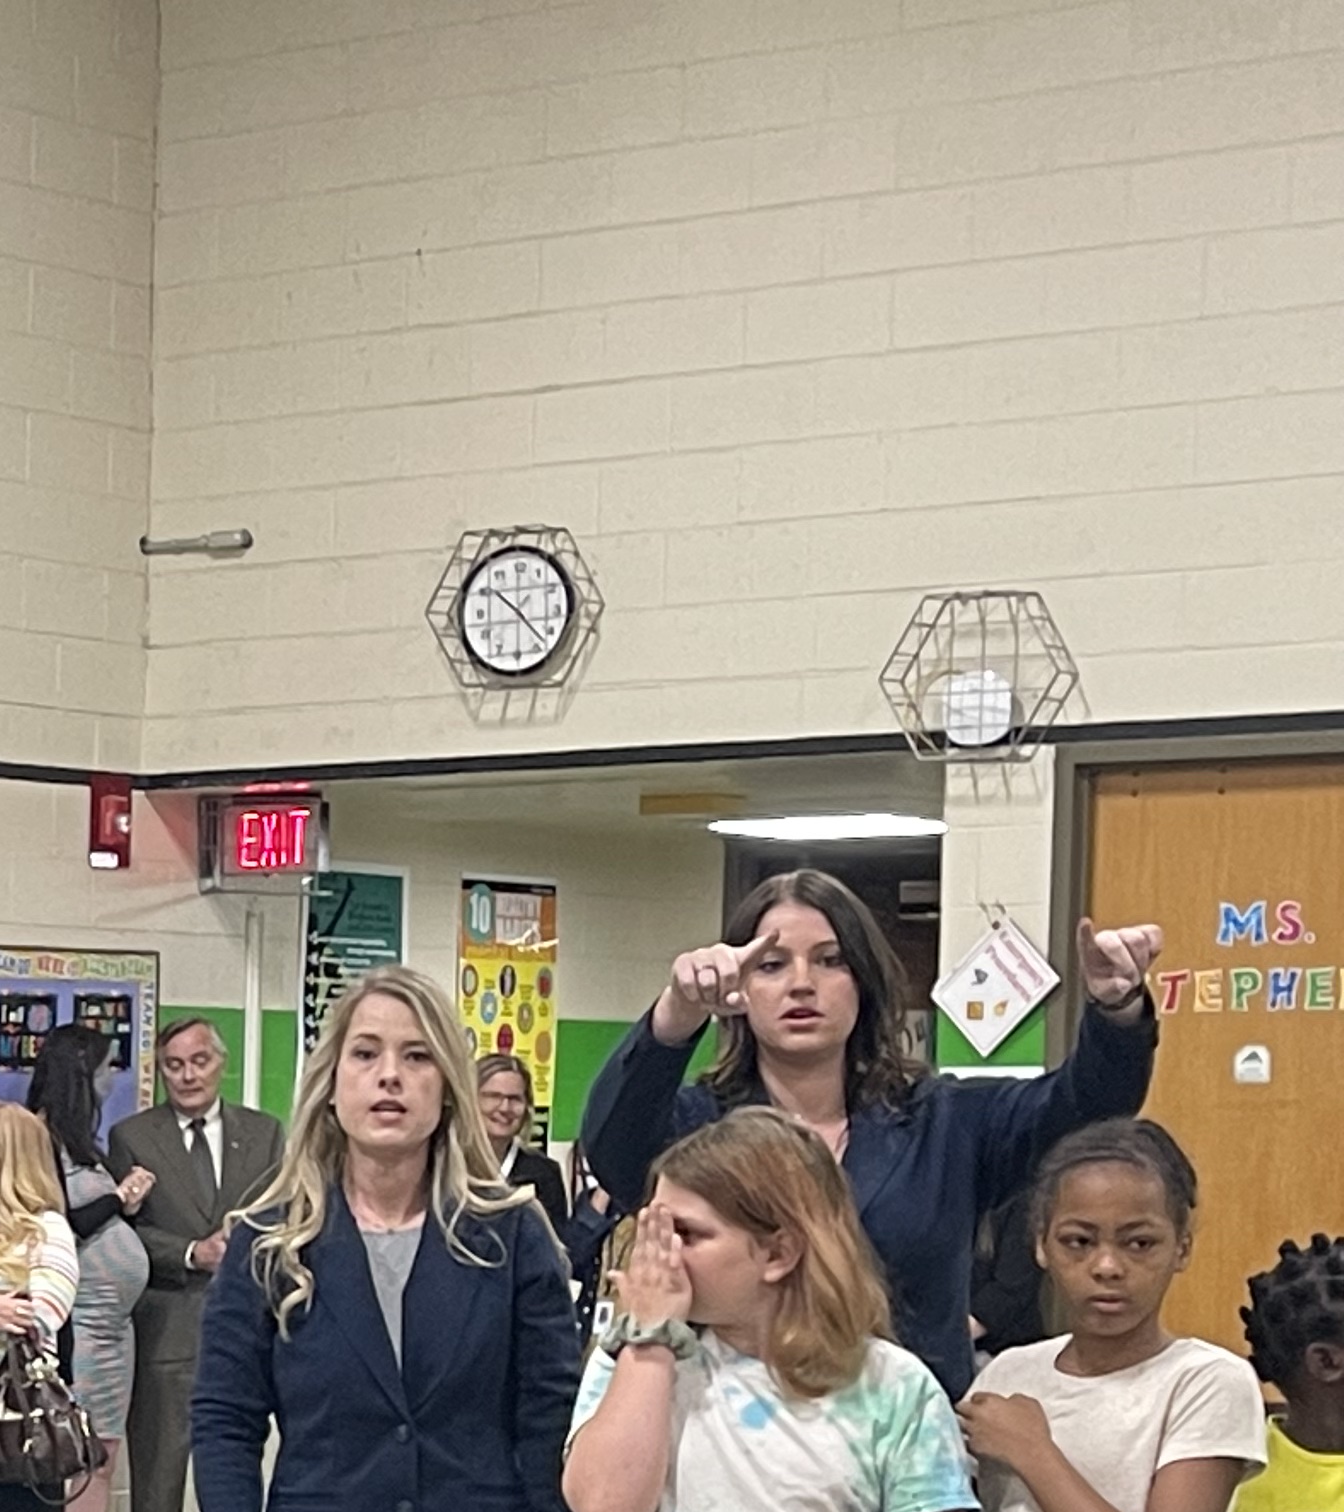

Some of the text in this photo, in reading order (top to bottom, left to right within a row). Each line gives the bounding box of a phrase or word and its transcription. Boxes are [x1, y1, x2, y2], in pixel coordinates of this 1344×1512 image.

[240, 809, 311, 868] EXIT
[470, 892, 491, 934] 10
[1216, 899, 1316, 948] MS.
